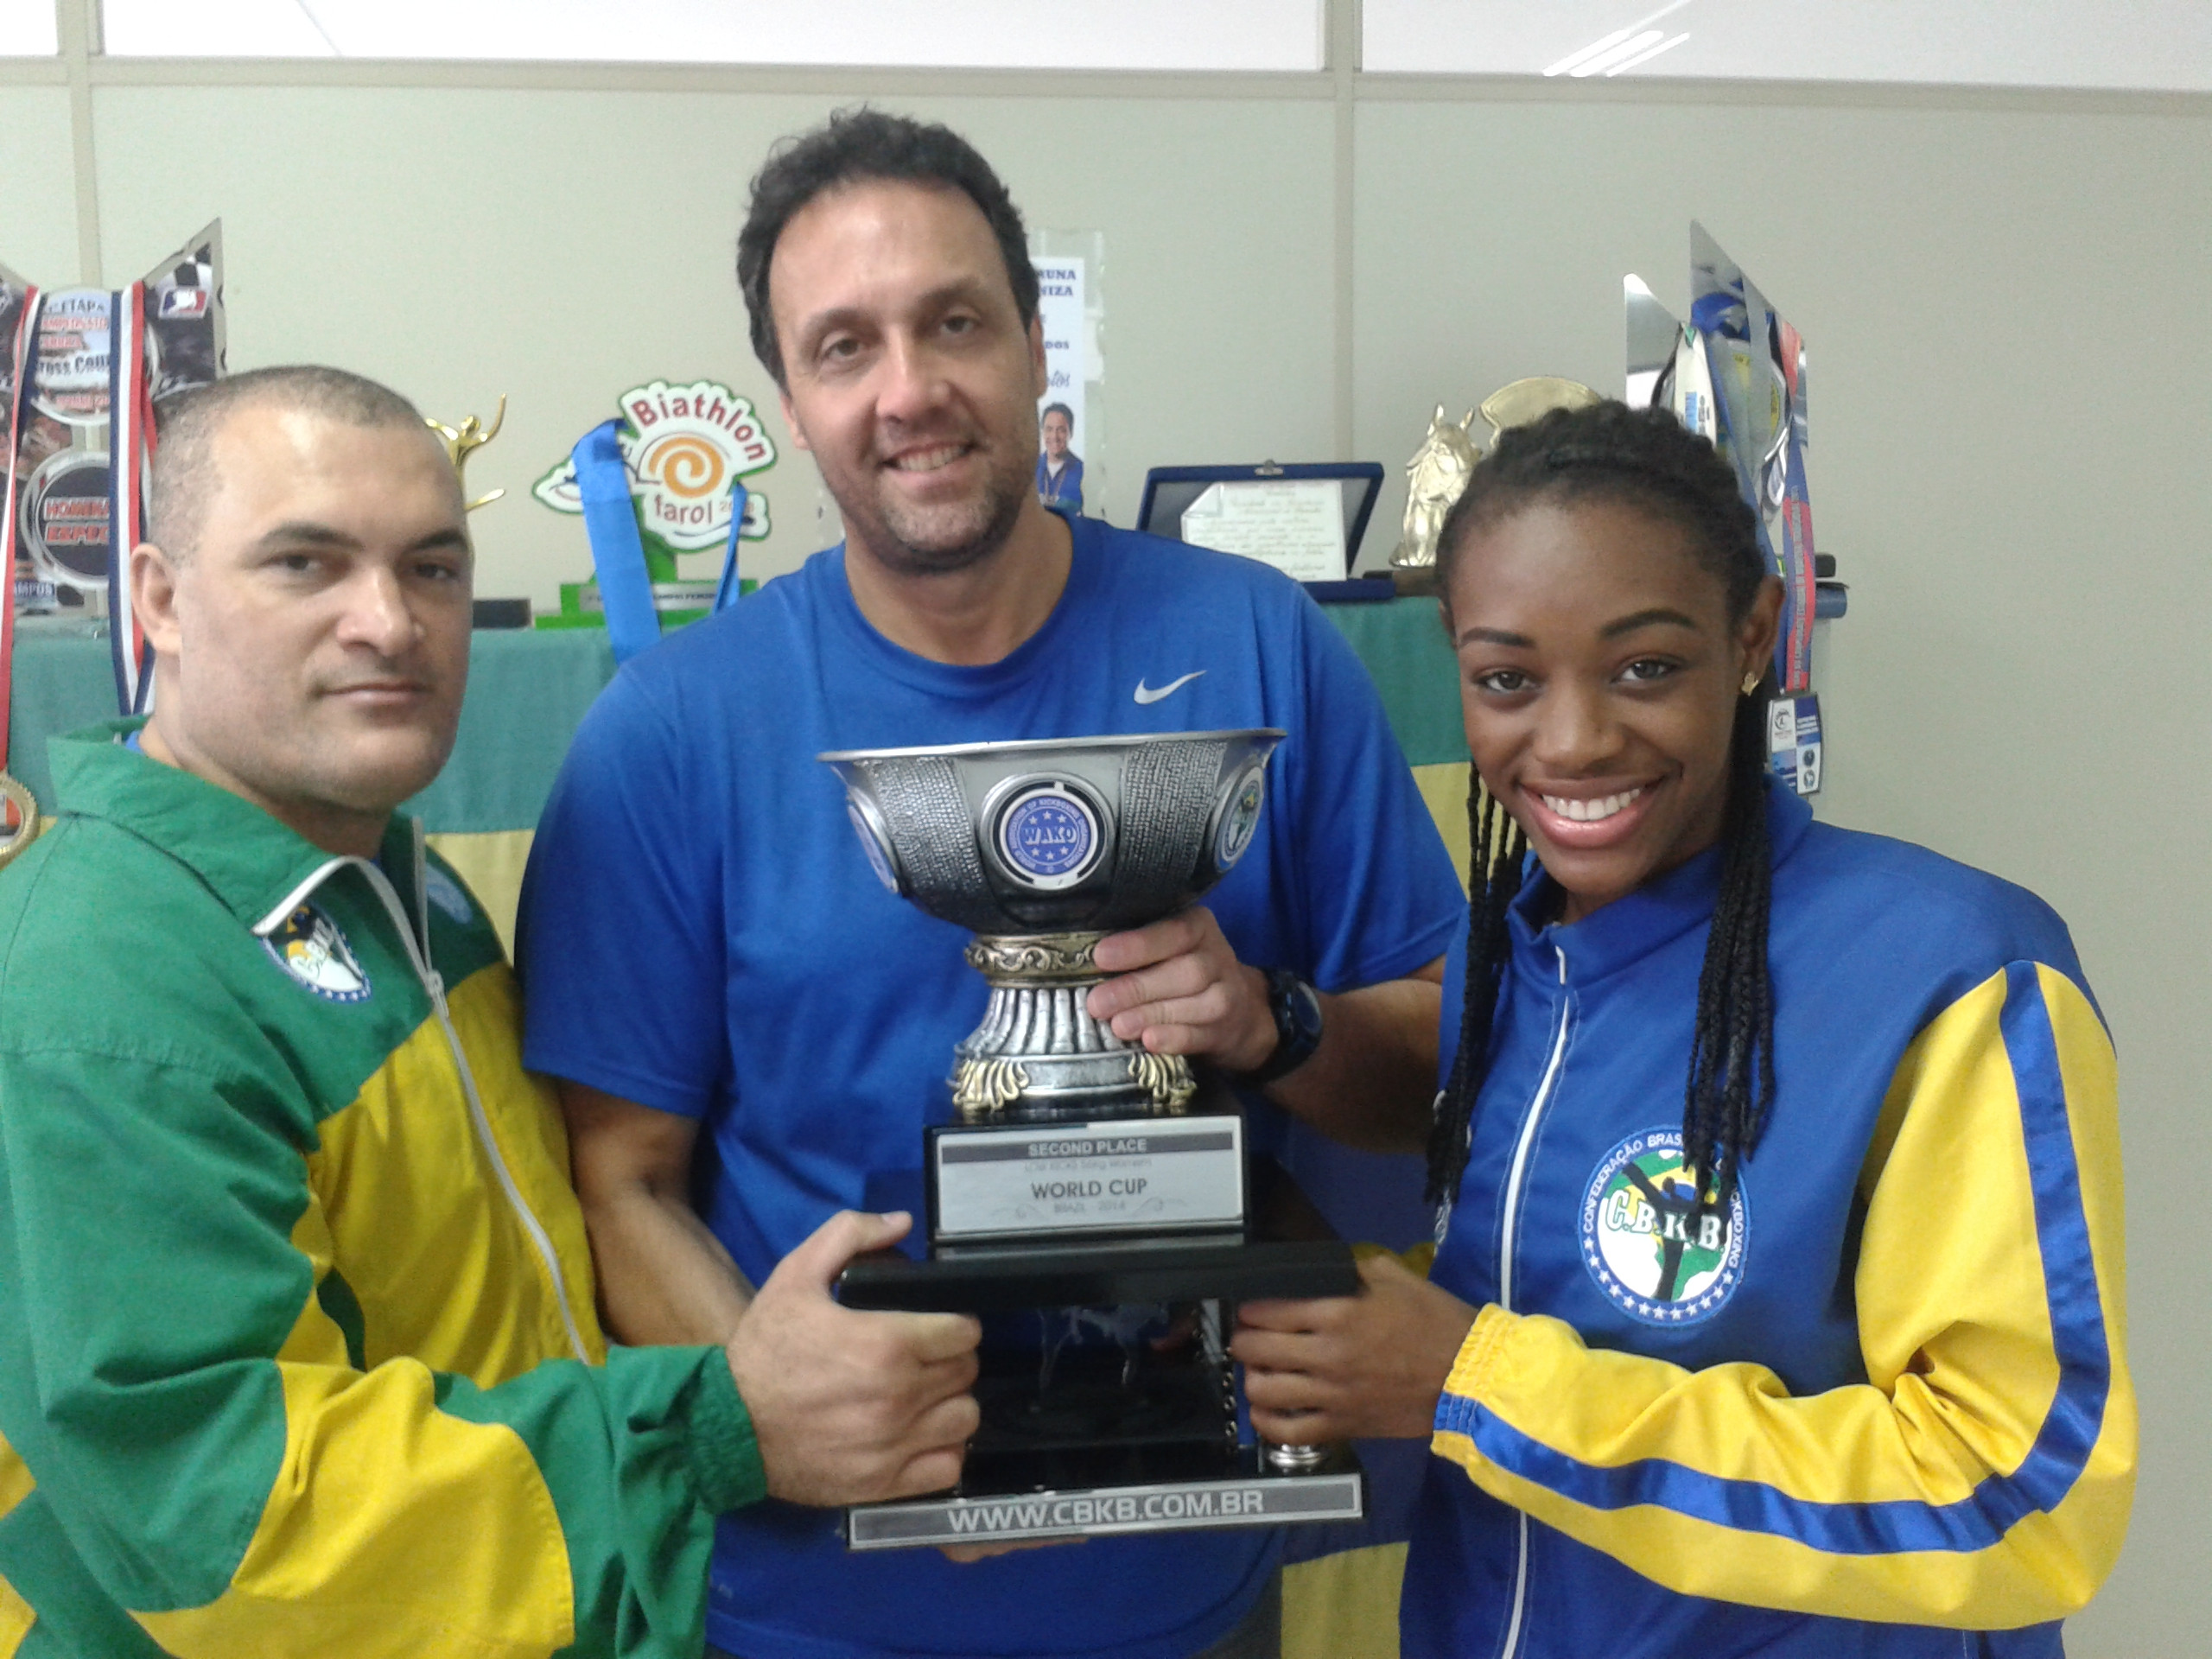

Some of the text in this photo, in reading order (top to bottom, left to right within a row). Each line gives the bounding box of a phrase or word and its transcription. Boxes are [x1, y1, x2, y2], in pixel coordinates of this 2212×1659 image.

[631, 393, 766, 462] Biathlon
[654, 493, 713, 524] farol
[1028, 1138, 1147, 1157] SECOND PLACE
[1647, 1133, 1683, 1148] BRAS
[1031, 1178, 1147, 1199] WORLD CUP
[949, 1489, 1264, 1534] WWW.CBKB.COM.BR
